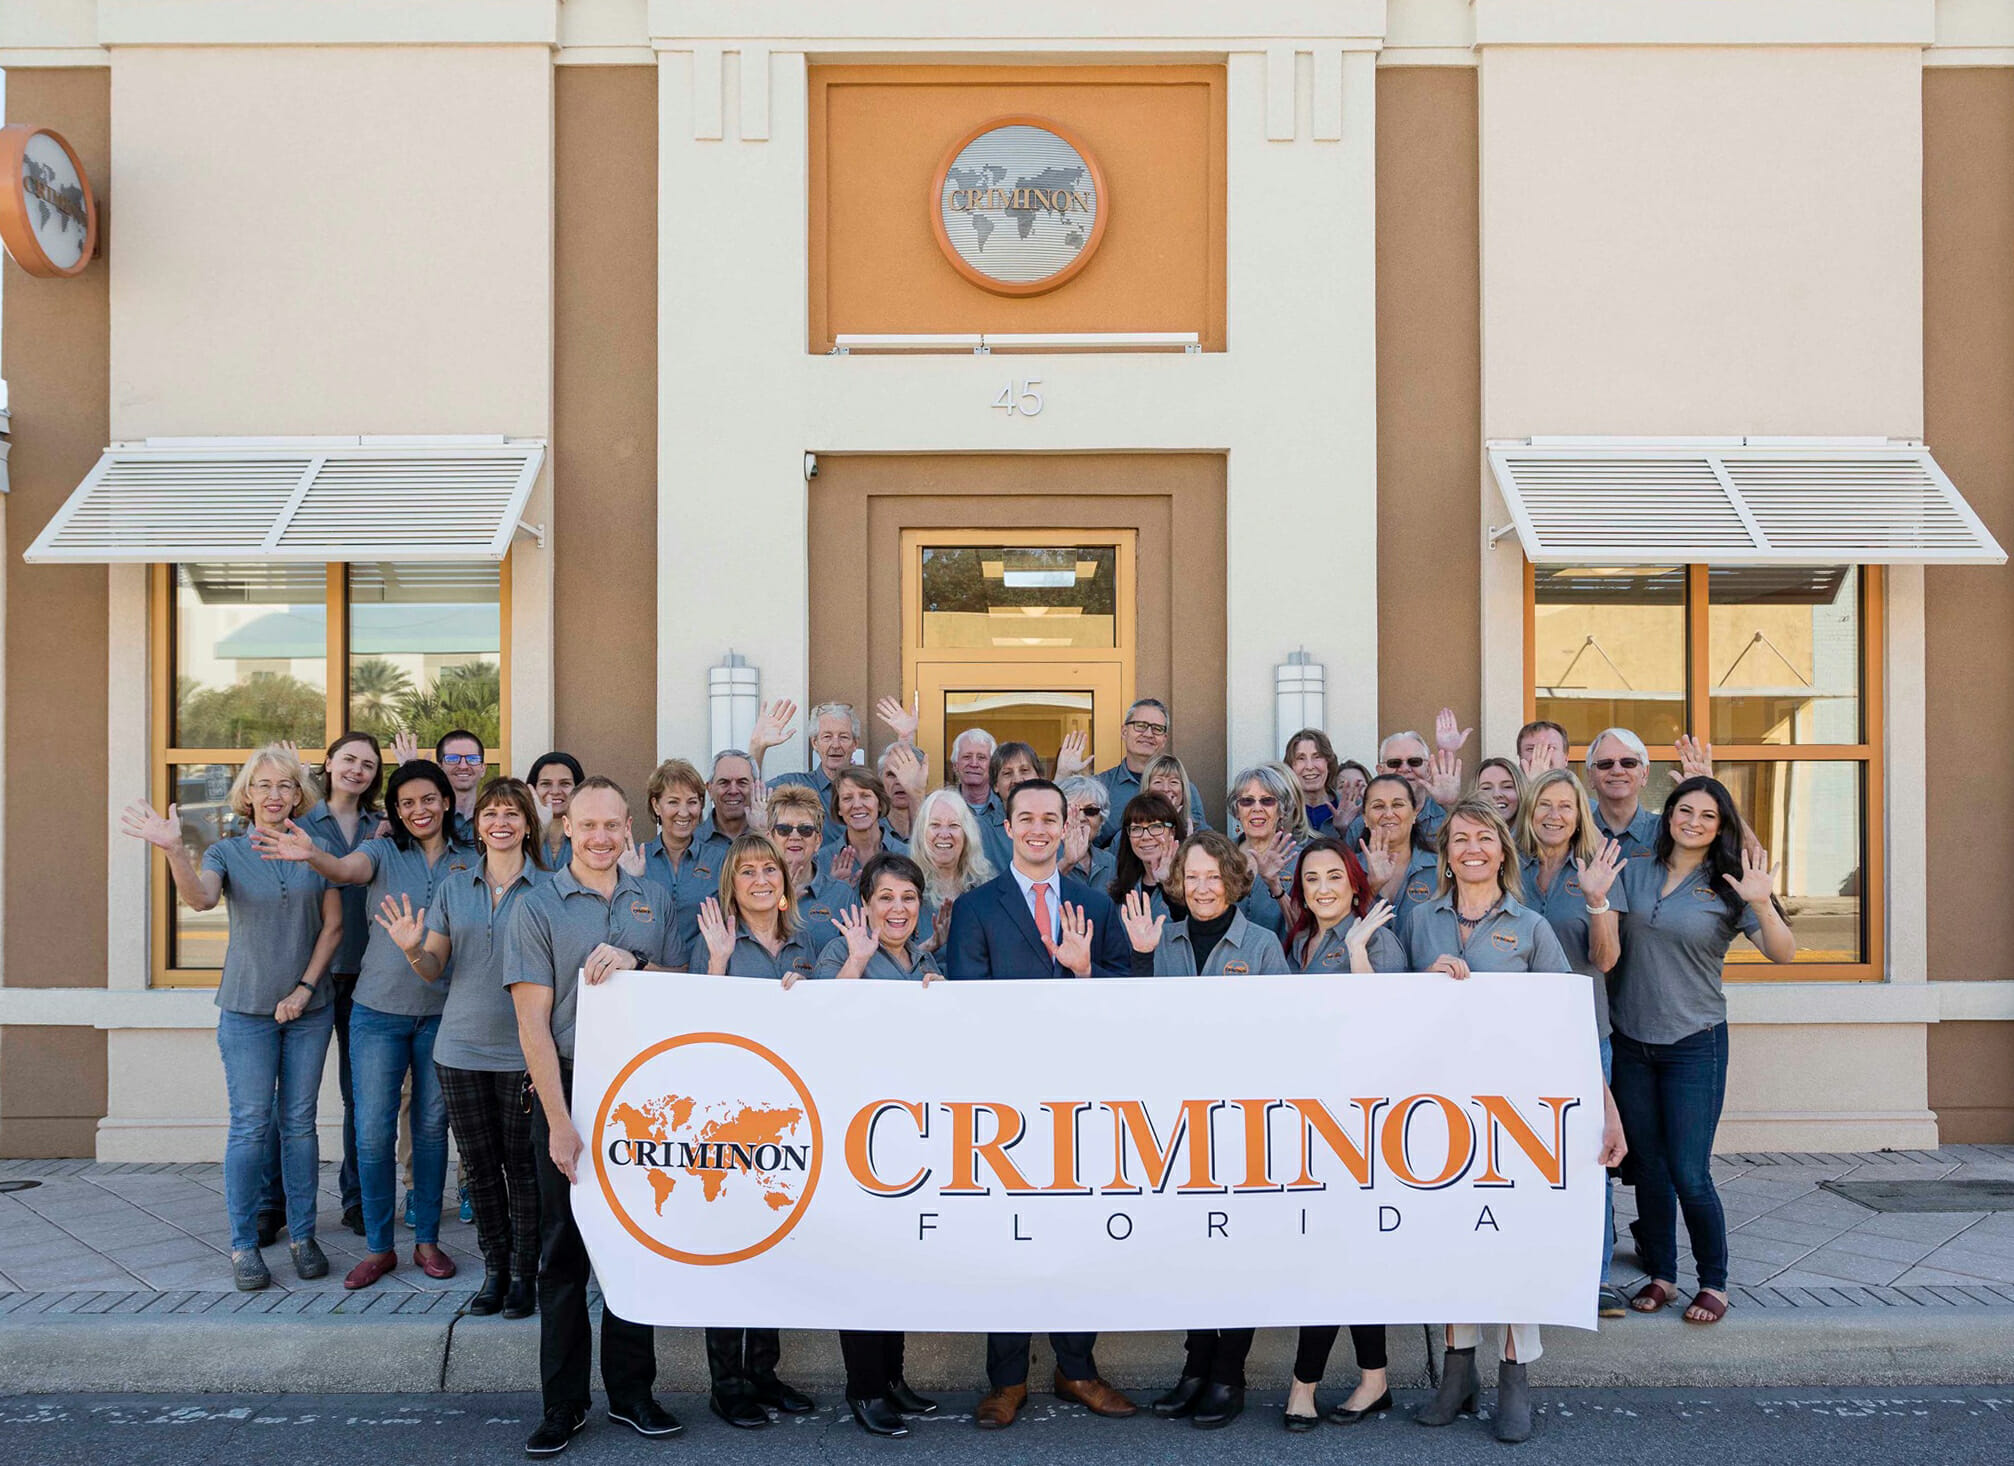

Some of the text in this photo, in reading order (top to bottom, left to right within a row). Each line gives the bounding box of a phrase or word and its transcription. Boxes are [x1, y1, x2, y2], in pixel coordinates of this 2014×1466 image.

[948, 188, 1091, 213] CRIMINON
[991, 378, 1044, 417] 45
[608, 1139, 810, 1171] CRIMINON
[844, 1093, 1581, 1198] CRIMINON
[919, 1204, 1500, 1241] FLORIDA
